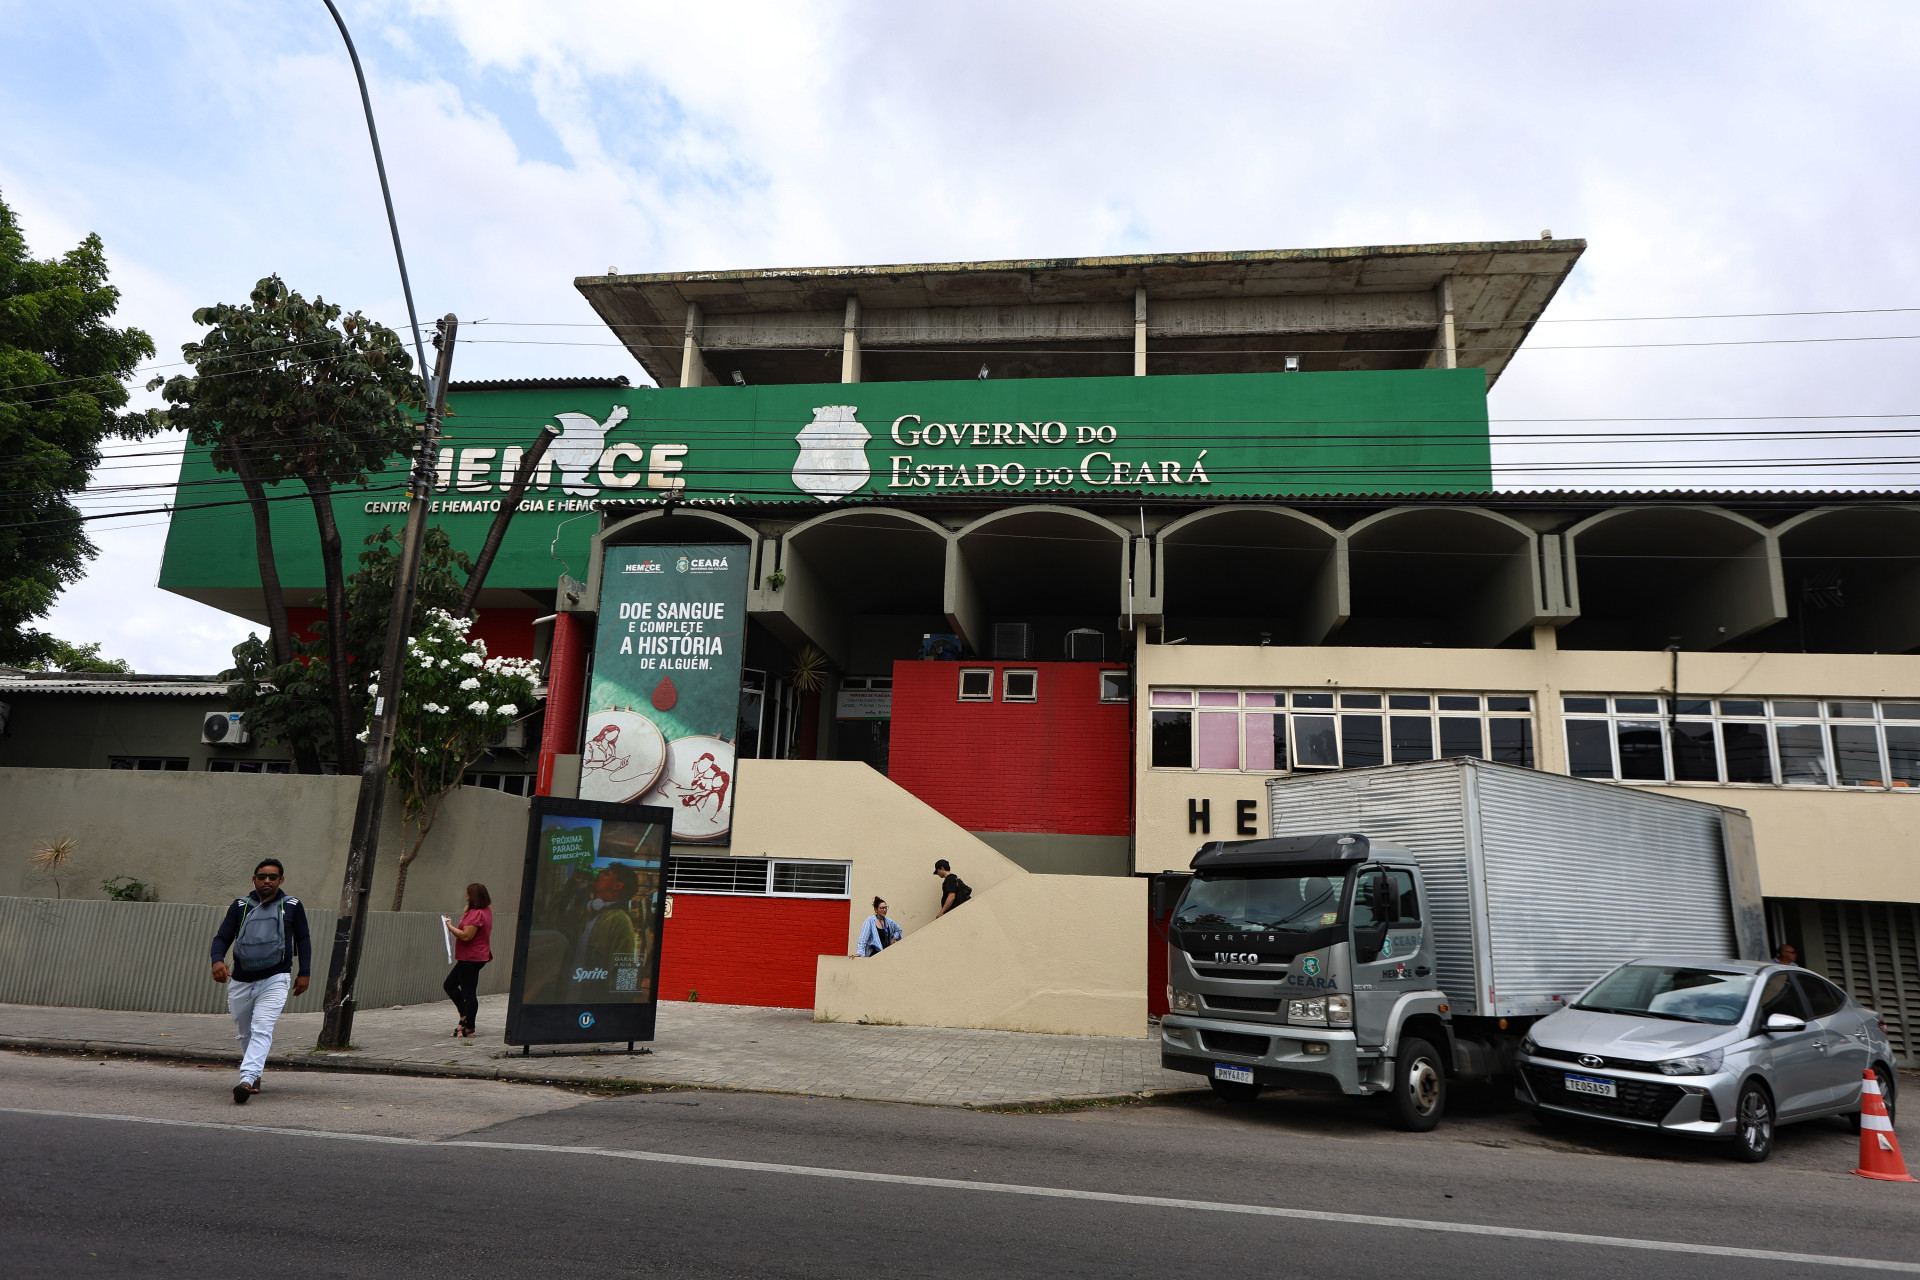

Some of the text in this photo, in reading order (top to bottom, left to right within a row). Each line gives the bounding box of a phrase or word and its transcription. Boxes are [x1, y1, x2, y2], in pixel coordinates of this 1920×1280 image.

[891, 414, 1117, 446] GOVERNO DO
[888, 449, 1212, 488] ESTADO DO CEARÁ
[364, 501, 411, 513] CENTR
[442, 500, 544, 513] HEMATOGIA
[547, 499, 555, 512] E
[690, 556, 729, 567] CEARÁ
[619, 602, 725, 620] DOE SANGUE
[628, 621, 704, 633] E COMPLETE
[620, 631, 723, 655] A HISTÓRIA
[640, 656, 713, 670] DE ALGUÉM.
[551, 834, 583, 845] PRÓXIMA
[552, 843, 582, 854] PARADA:
[1202, 934, 1276, 943] VERTIS
[1214, 952, 1259, 965] IVECO
[572, 967, 609, 983] Sprite
[1287, 974, 1338, 990] CEARÁ
